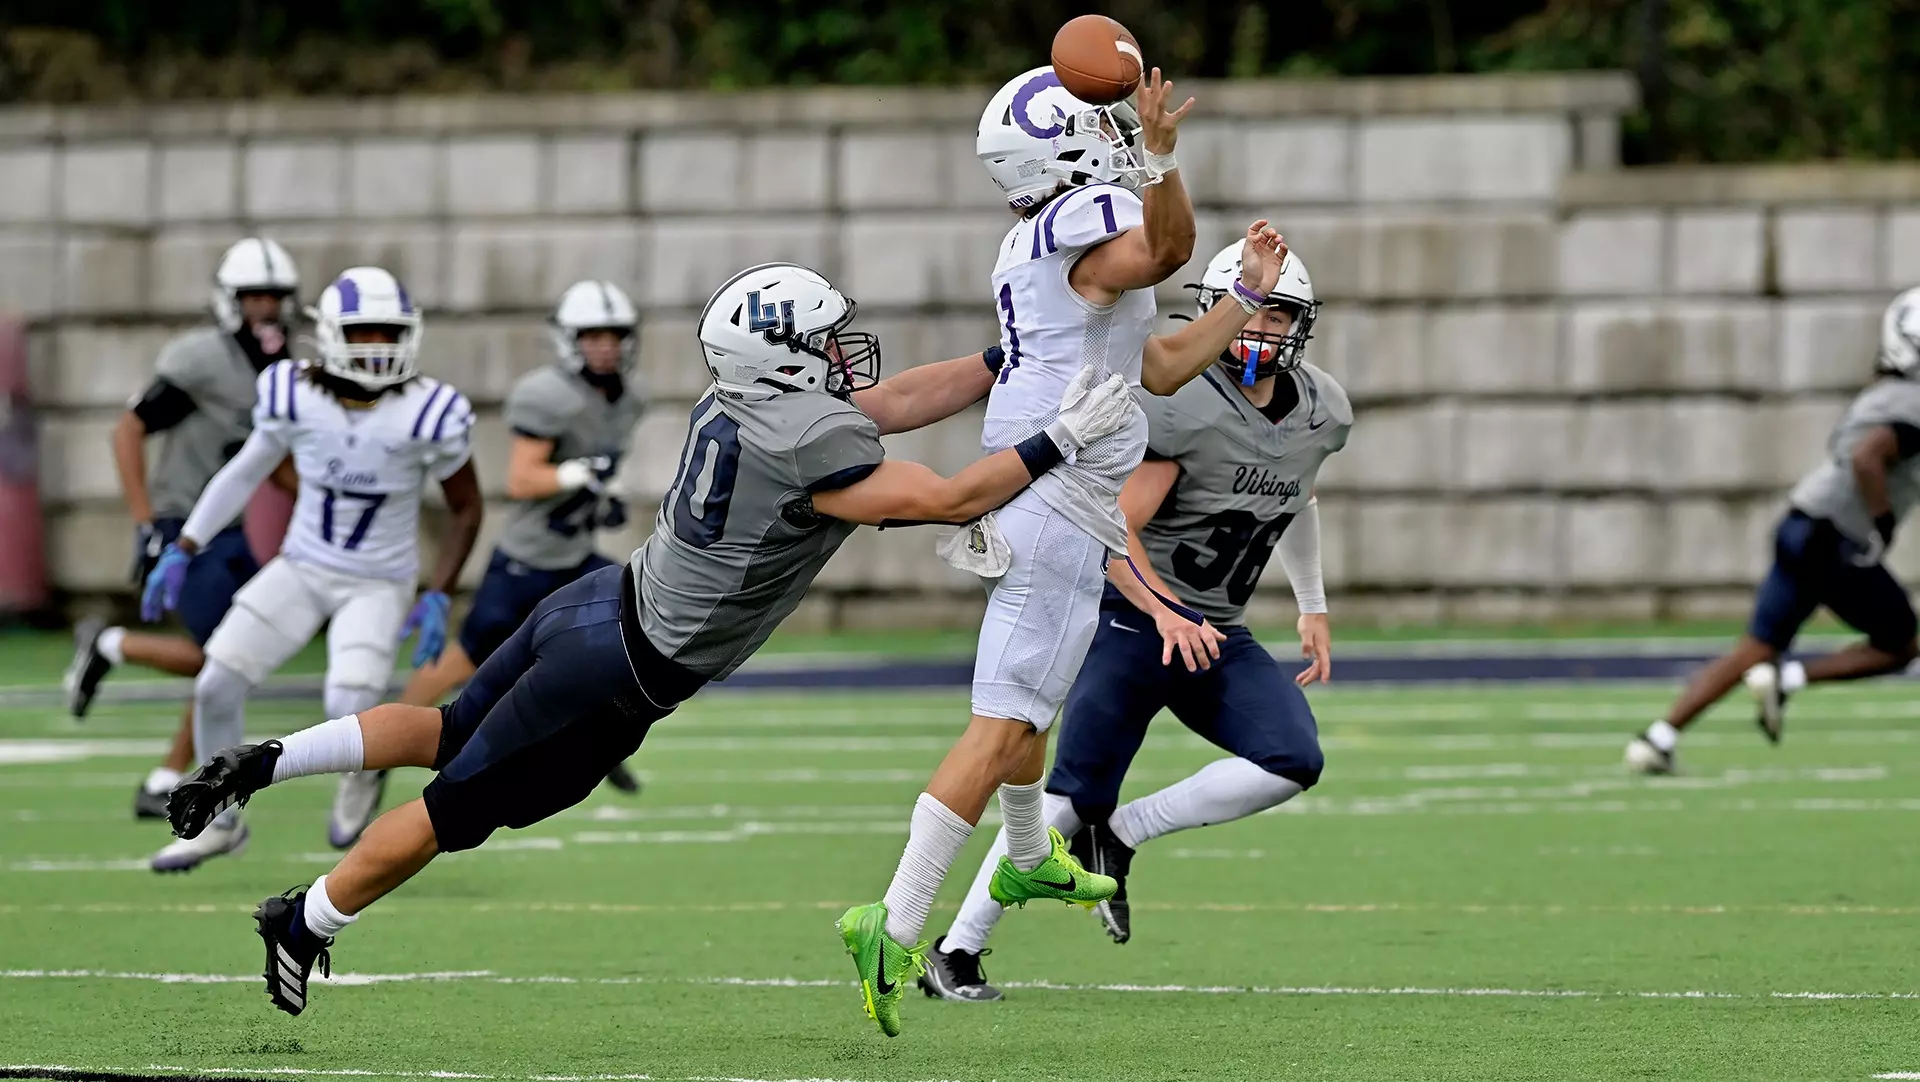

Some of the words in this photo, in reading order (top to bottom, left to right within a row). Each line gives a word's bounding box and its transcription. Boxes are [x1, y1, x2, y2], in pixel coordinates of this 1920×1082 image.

[1093, 194, 1118, 234] 1
[747, 290, 796, 346] LU
[999, 283, 1024, 385] 1
[1233, 466, 1301, 505] Vikings
[319, 485, 388, 550] 17
[1171, 509, 1296, 607] 36
